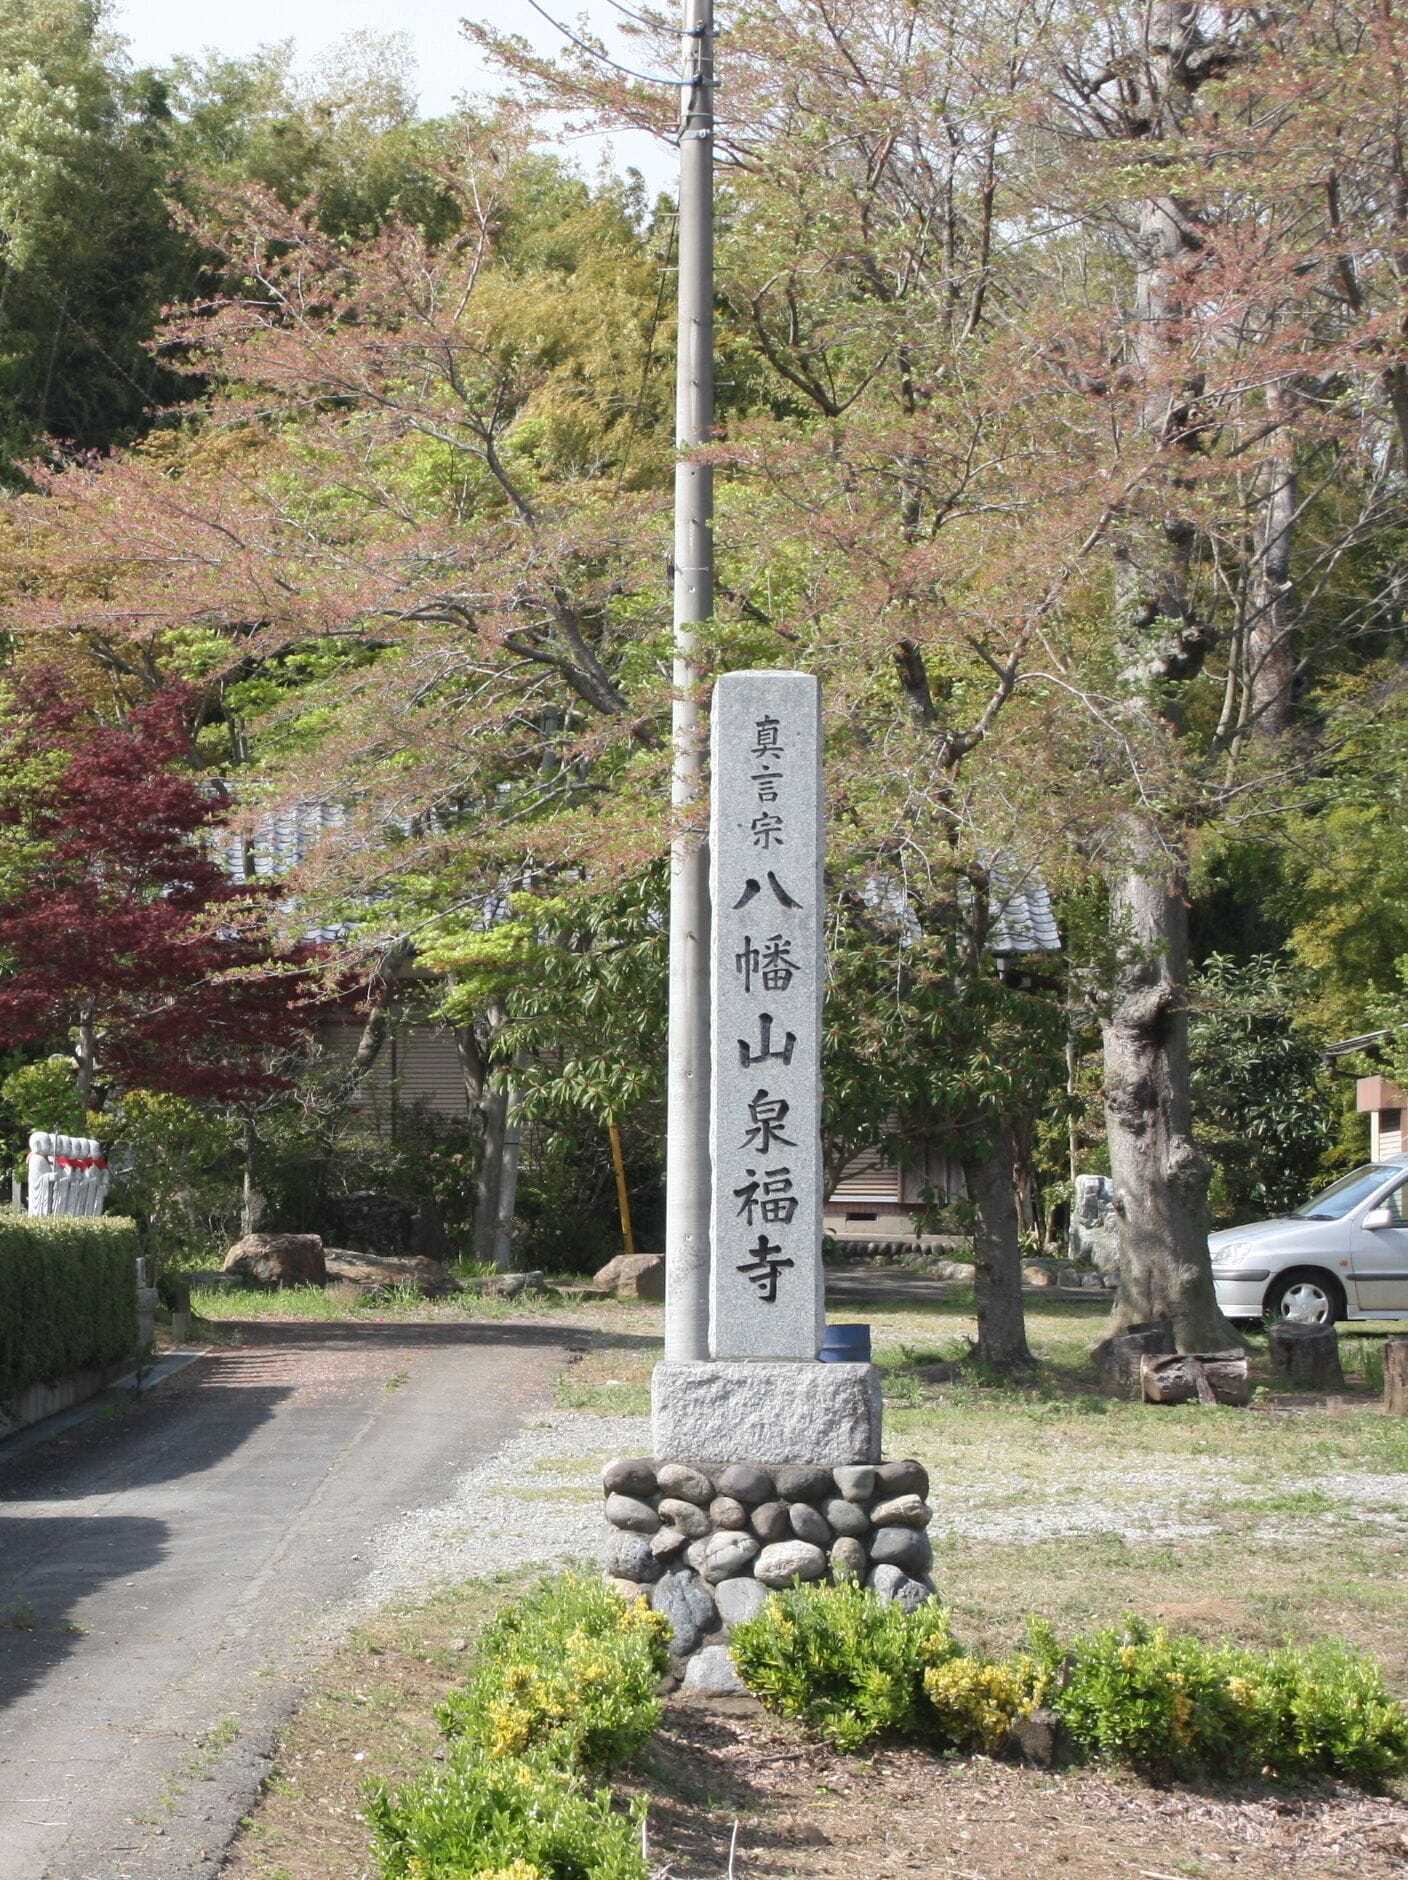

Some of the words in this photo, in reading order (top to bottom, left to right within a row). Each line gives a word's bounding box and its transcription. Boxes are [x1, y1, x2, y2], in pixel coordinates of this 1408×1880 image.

[749, 714, 784, 850] 真言宗
[732, 870, 803, 1302] 八幡山泉福寺
